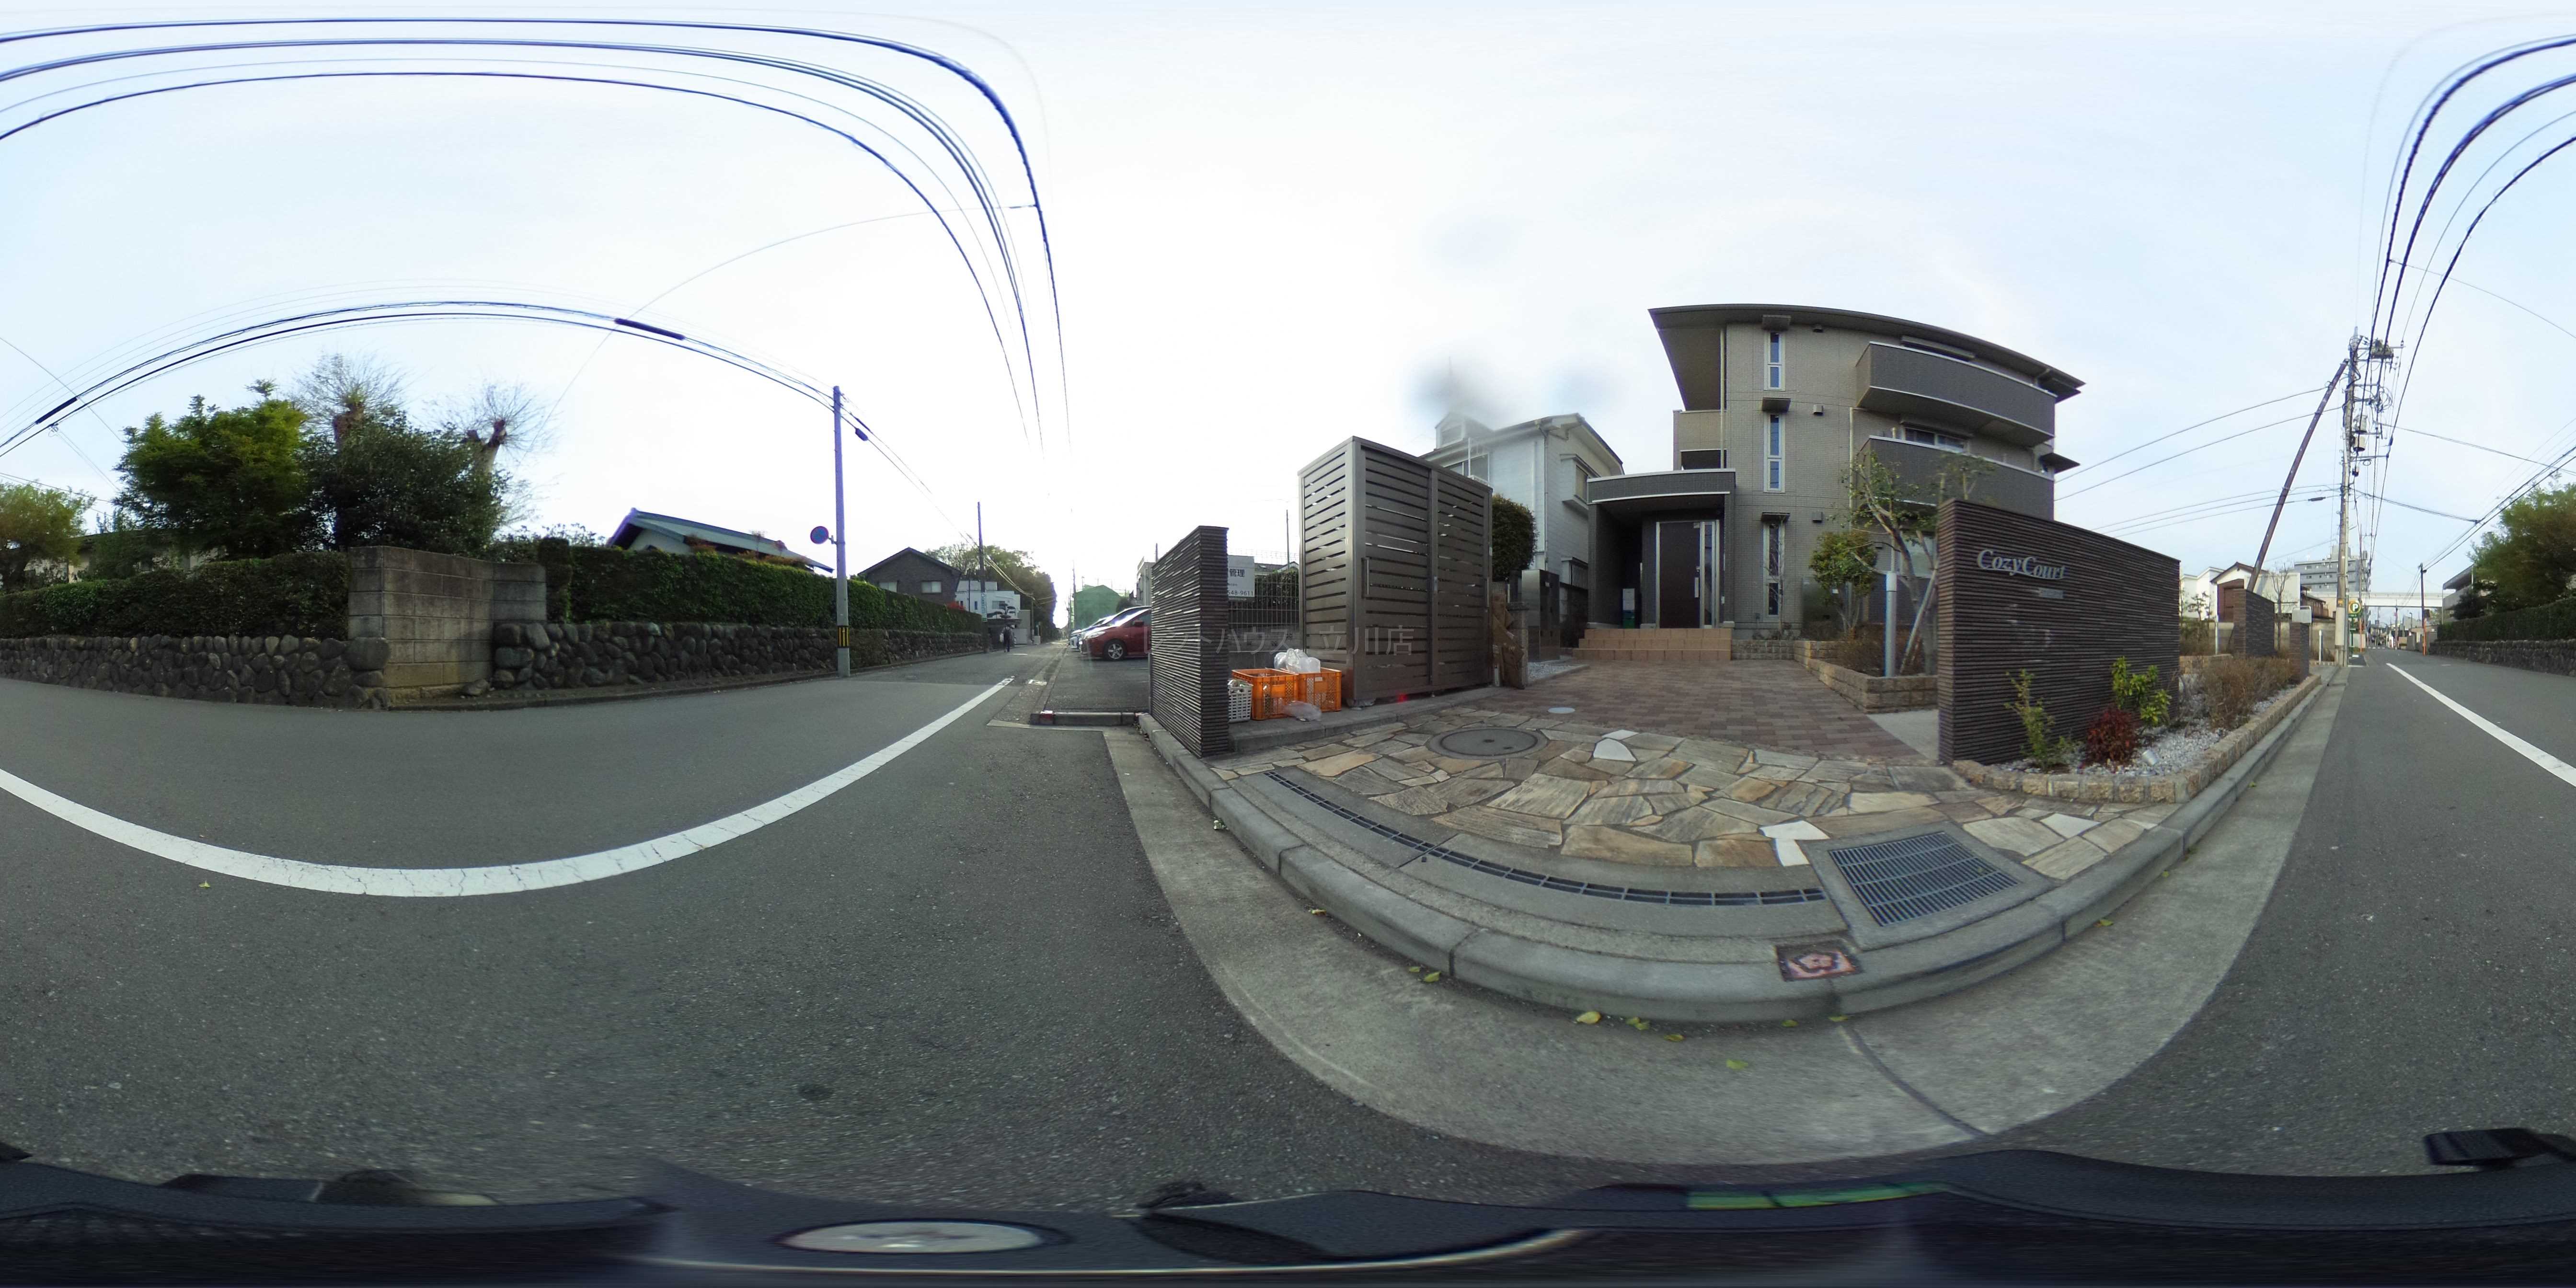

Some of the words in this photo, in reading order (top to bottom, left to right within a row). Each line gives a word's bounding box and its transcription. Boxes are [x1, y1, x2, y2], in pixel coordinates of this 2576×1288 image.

[1978, 550, 2065, 580] CozyCourt
[1230, 569, 1245, 577] 管理
[2352, 603, 2358, 611] P
